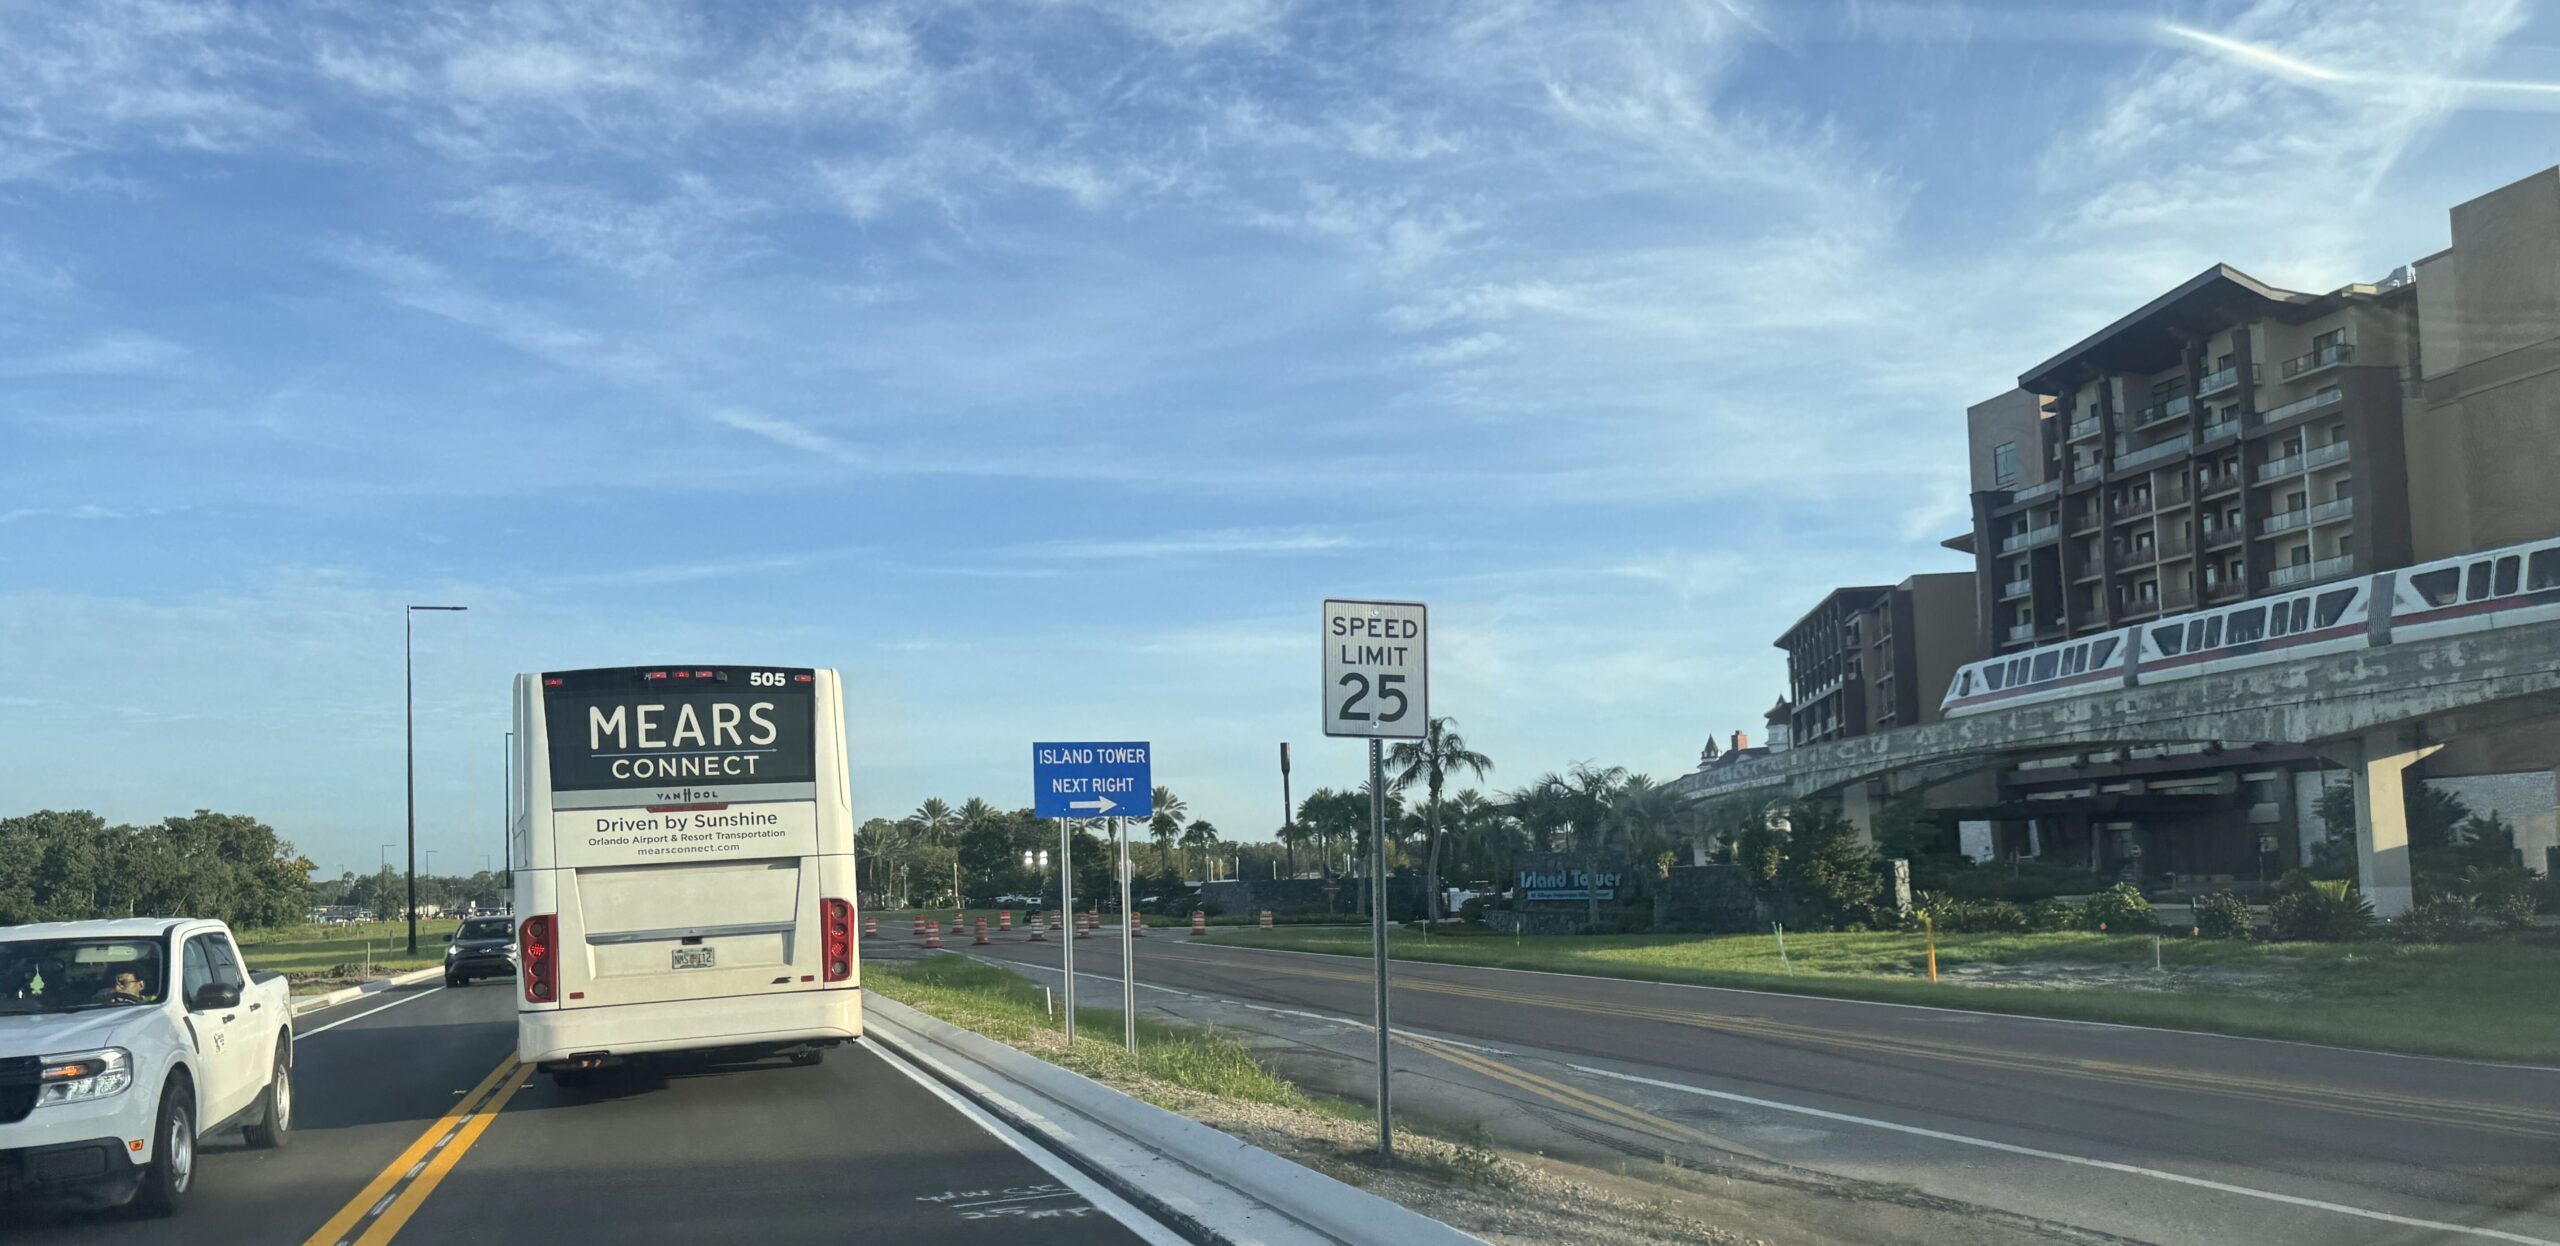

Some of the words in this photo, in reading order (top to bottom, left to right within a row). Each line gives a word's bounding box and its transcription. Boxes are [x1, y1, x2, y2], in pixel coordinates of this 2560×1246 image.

[1332, 616, 1418, 639] SPEED
[1341, 644, 1408, 667] LIMIT
[750, 671, 786, 687] 505
[1338, 672, 1408, 723] 25
[589, 702, 777, 750] MEARS
[1039, 748, 1093, 765] ISLAND
[1097, 748, 1146, 764] TOWER
[612, 755, 760, 779] CONNECT
[1053, 778, 1089, 793] NEXT
[1092, 777, 1134, 793] RIGHT
[596, 817, 659, 833] Driven
[665, 815, 688, 832] by
[694, 811, 778, 828] Sunshine
[588, 836, 630, 847] Orlando
[632, 834, 668, 845] Airport
[671, 834, 678, 842] &
[680, 832, 713, 842] Resort
[715, 829, 786, 841] Transportation
[637, 842, 740, 856] mearsconnect.com
[1520, 869, 1567, 888] Island
